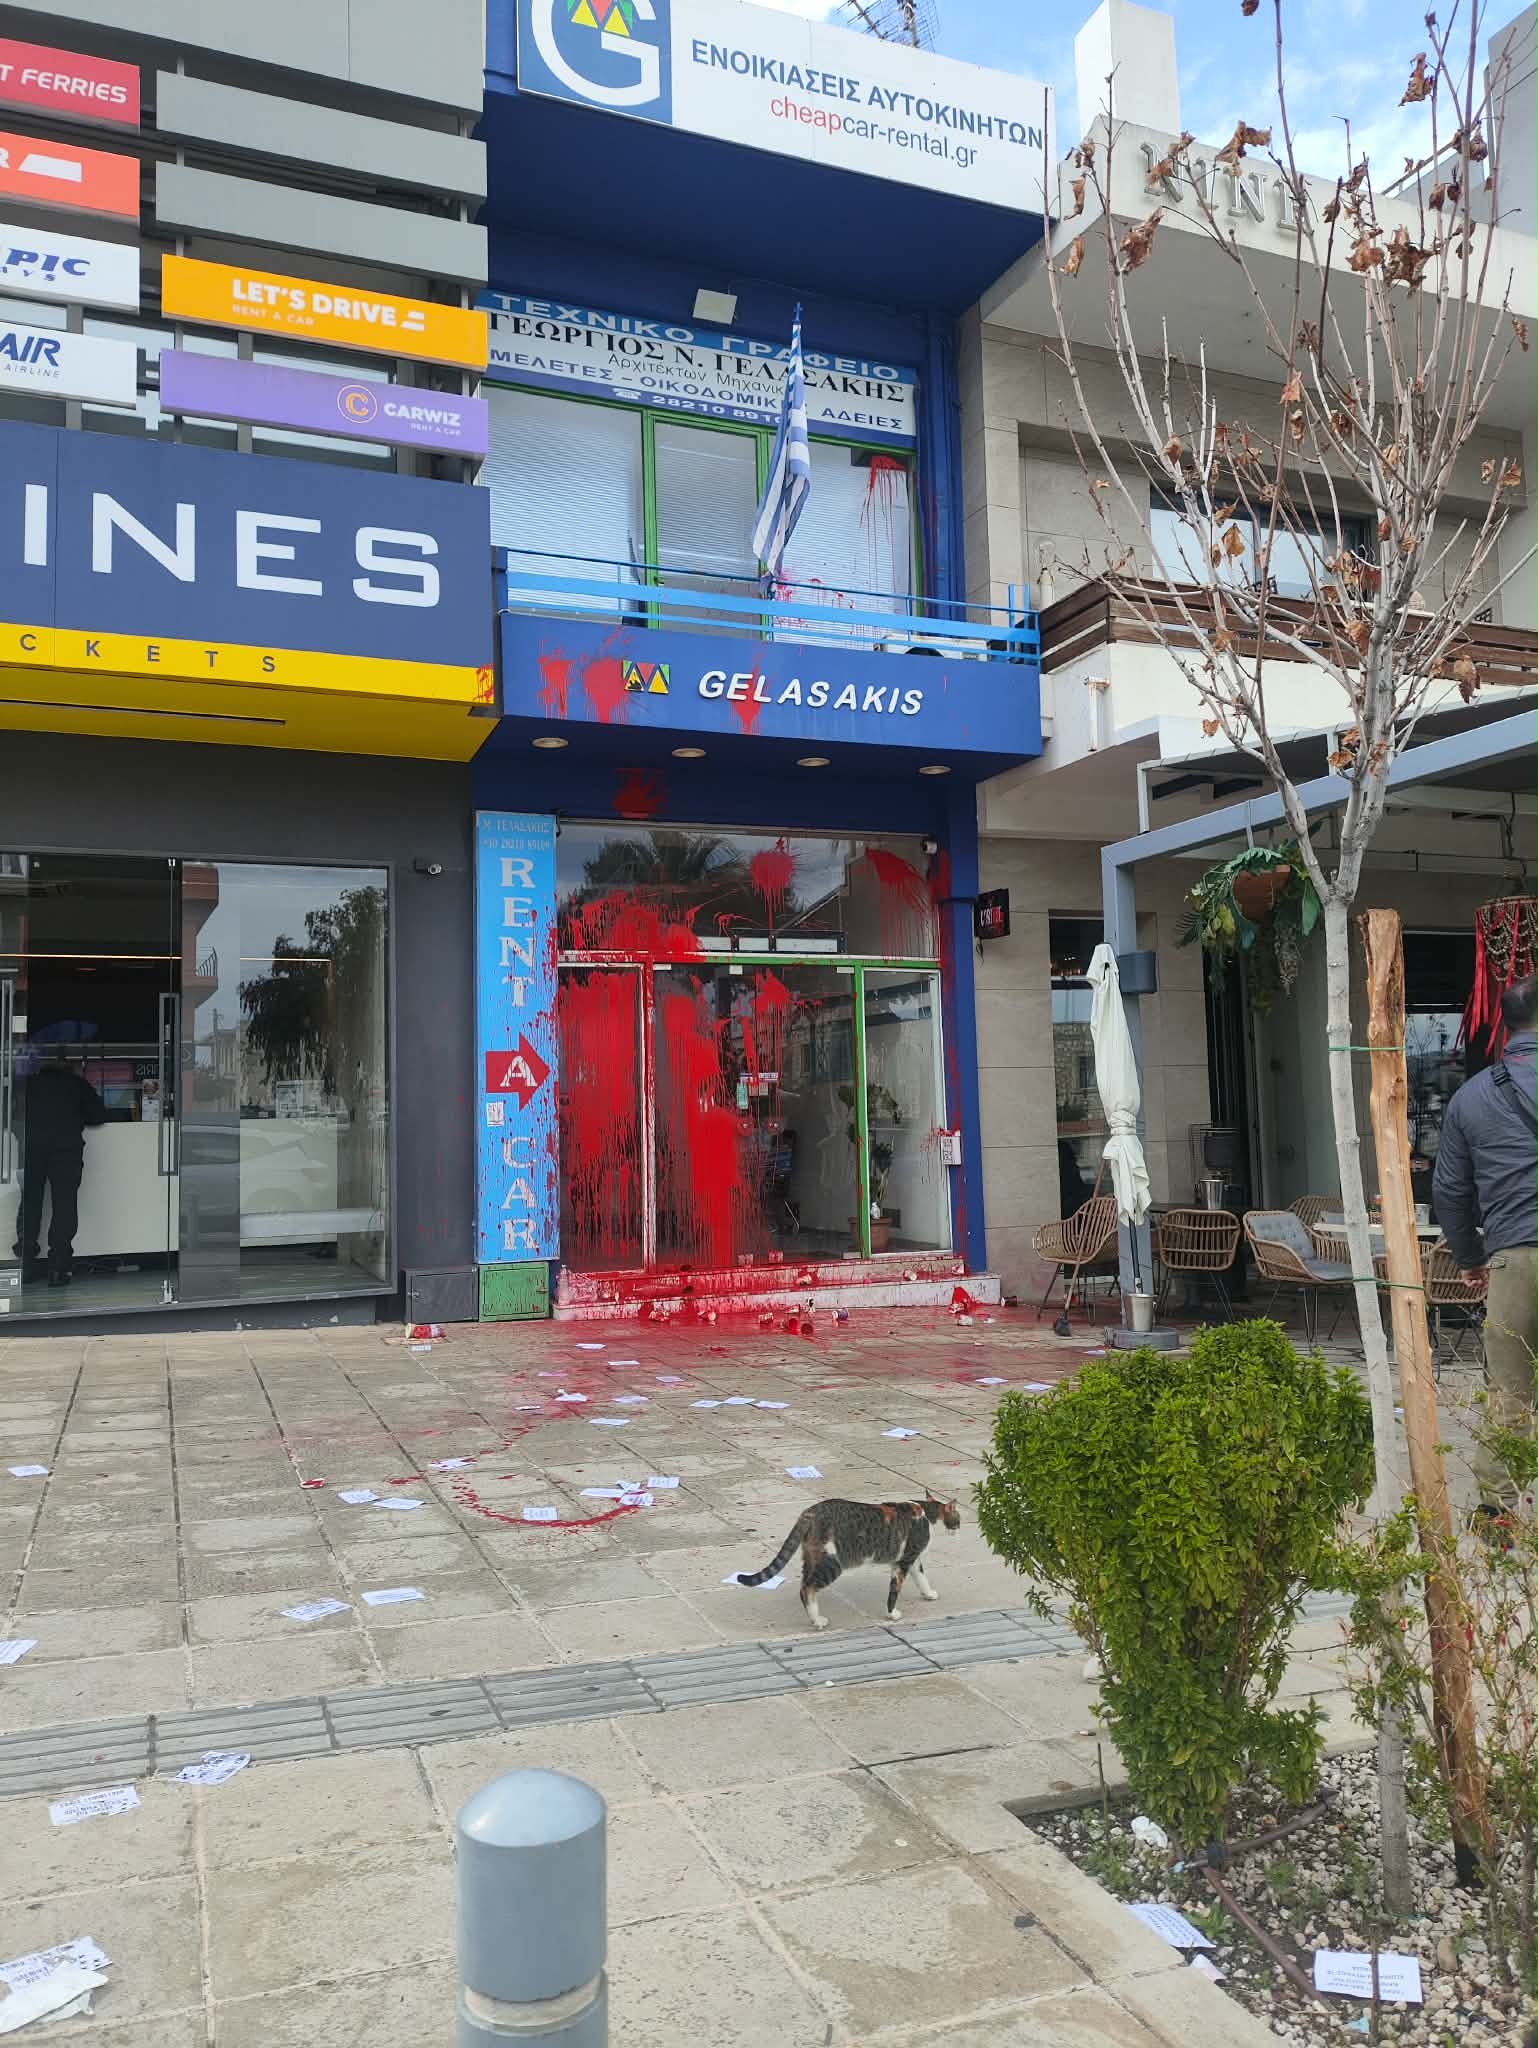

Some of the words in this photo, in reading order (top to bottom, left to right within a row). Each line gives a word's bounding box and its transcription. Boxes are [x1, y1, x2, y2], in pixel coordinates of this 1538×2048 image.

[21, 68, 128, 104] FERRIES
[691, 39, 862, 104] ΕΝΟΙΚΙΑΣΕΙΣ
[867, 87, 1043, 151] ΑΥΤΟΚΙΝΗΤΩΝ
[770, 94, 978, 168] cheapcar-rental.gr
[5, 248, 91, 276] PIC
[232, 279, 307, 311] LET'S
[312, 294, 397, 327] DRIVE
[232, 304, 268, 319] RENT
[273, 311, 282, 321] A
[287, 314, 315, 326] CAR
[0, 332, 61, 367] AIR
[488, 311, 665, 361] ΓΕΩΡΓΙΟΣ
[674, 346, 704, 368] Ν.
[492, 293, 695, 343] ΤΕΧΝΙΚΟ
[722, 336, 899, 381] ΓΡΑΦΕΙΟ
[4, 363, 61, 377] AIRLINE
[490, 348, 613, 381] ΜΕΛΕΤΕΣ
[640, 375, 807, 414] ΟΙΚΟΔΟΜΙΚ
[821, 407, 904, 430] ΑΔΕΙΕΣ
[608, 353, 707, 381] Αρχιτέκτων
[716, 372, 784, 395] Μηχανικ
[383, 402, 462, 427] CARWIZ
[652, 395, 726, 414] 28210
[24, 483, 441, 608] INES
[20, 633, 276, 673] CKETS
[698, 670, 923, 715] GELASAKIS
[498, 857, 536, 1008] RENT
[499, 1055, 538, 1087] A
[501, 1137, 540, 1250] CAR
